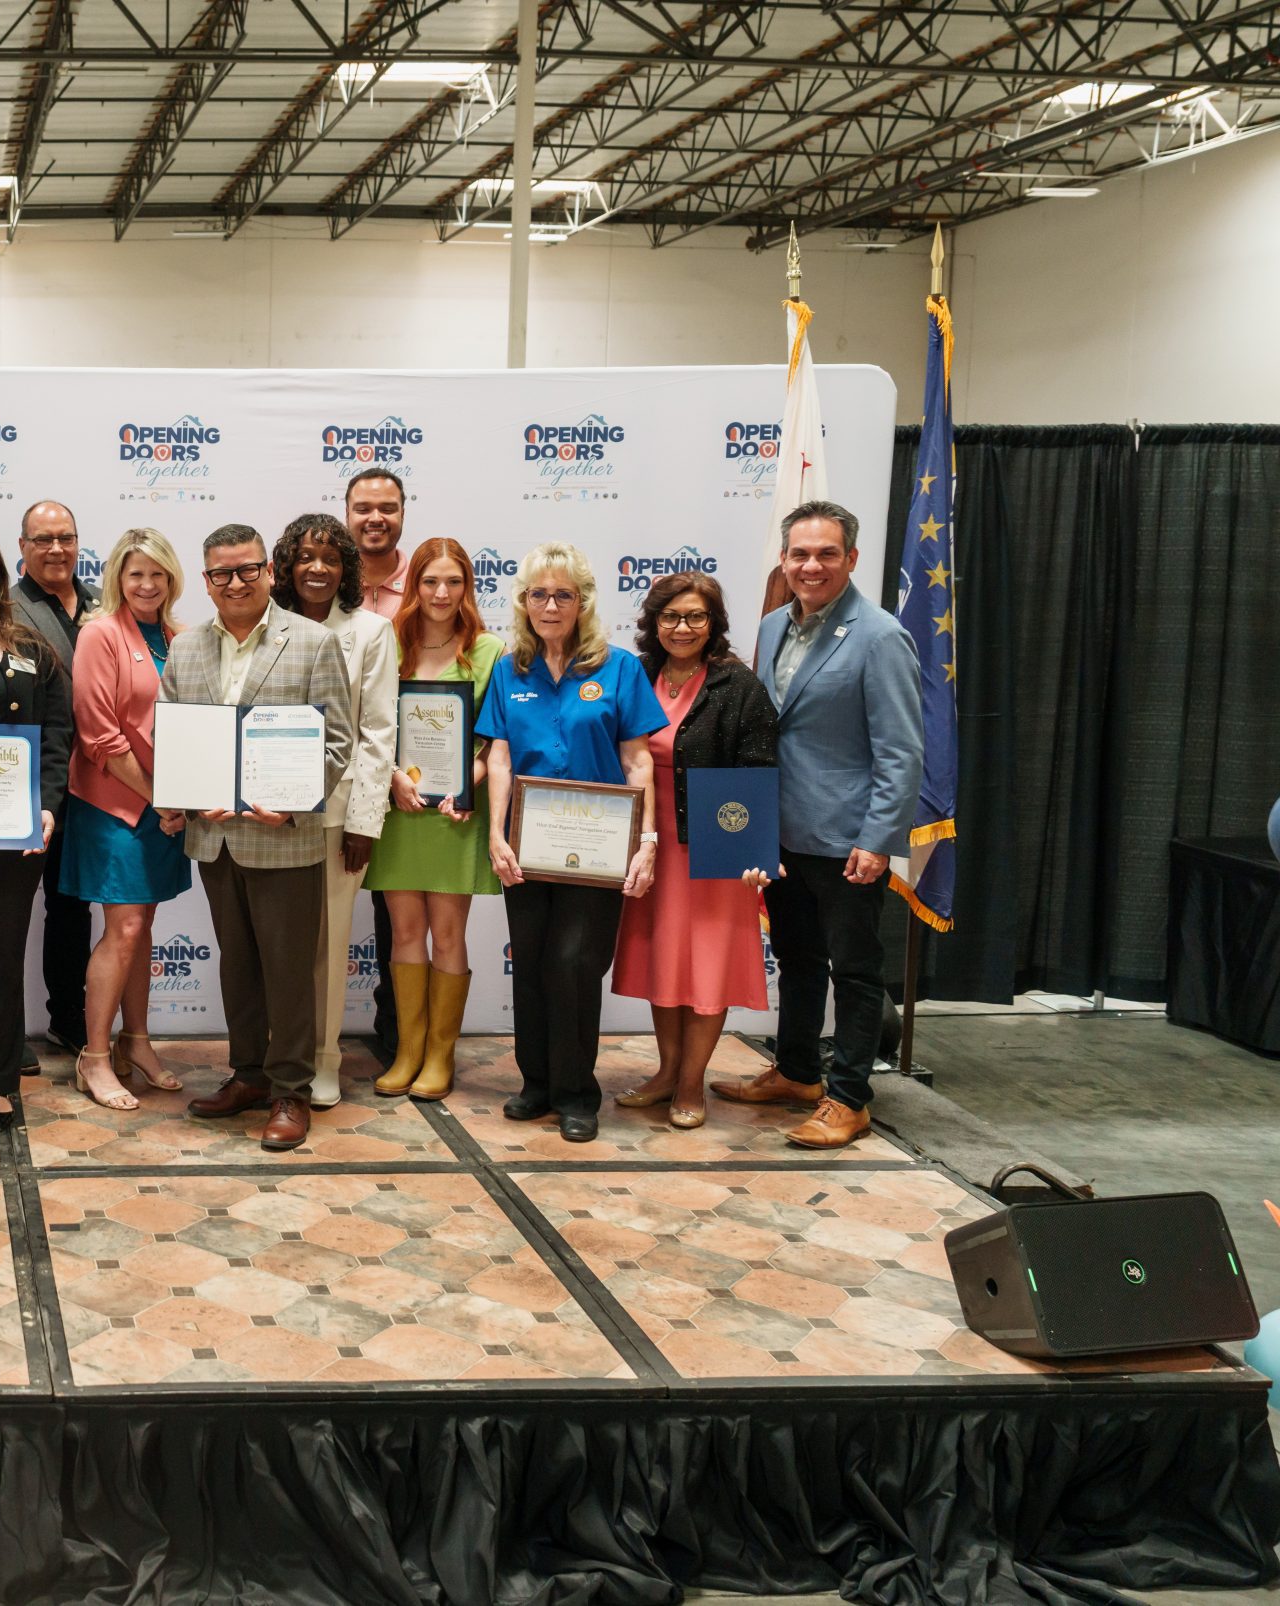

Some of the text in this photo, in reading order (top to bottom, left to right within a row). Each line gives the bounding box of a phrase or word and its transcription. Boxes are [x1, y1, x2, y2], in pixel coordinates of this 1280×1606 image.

[119, 423, 220, 444] OPENING
[322, 425, 423, 446] OPENING
[524, 424, 624, 443] OPENING
[120, 444, 200, 461] DOORS
[322, 445, 403, 462] DOORS
[524, 444, 604, 460] DOORS
[132, 457, 211, 487] Together
[536, 457, 614, 486] Together
[618, 556, 717, 574] OPENING
[407, 704, 455, 723] Assembly
[549, 800, 605, 819] CHINO
[151, 945, 211, 960] ENING
[150, 962, 192, 977] ORS
